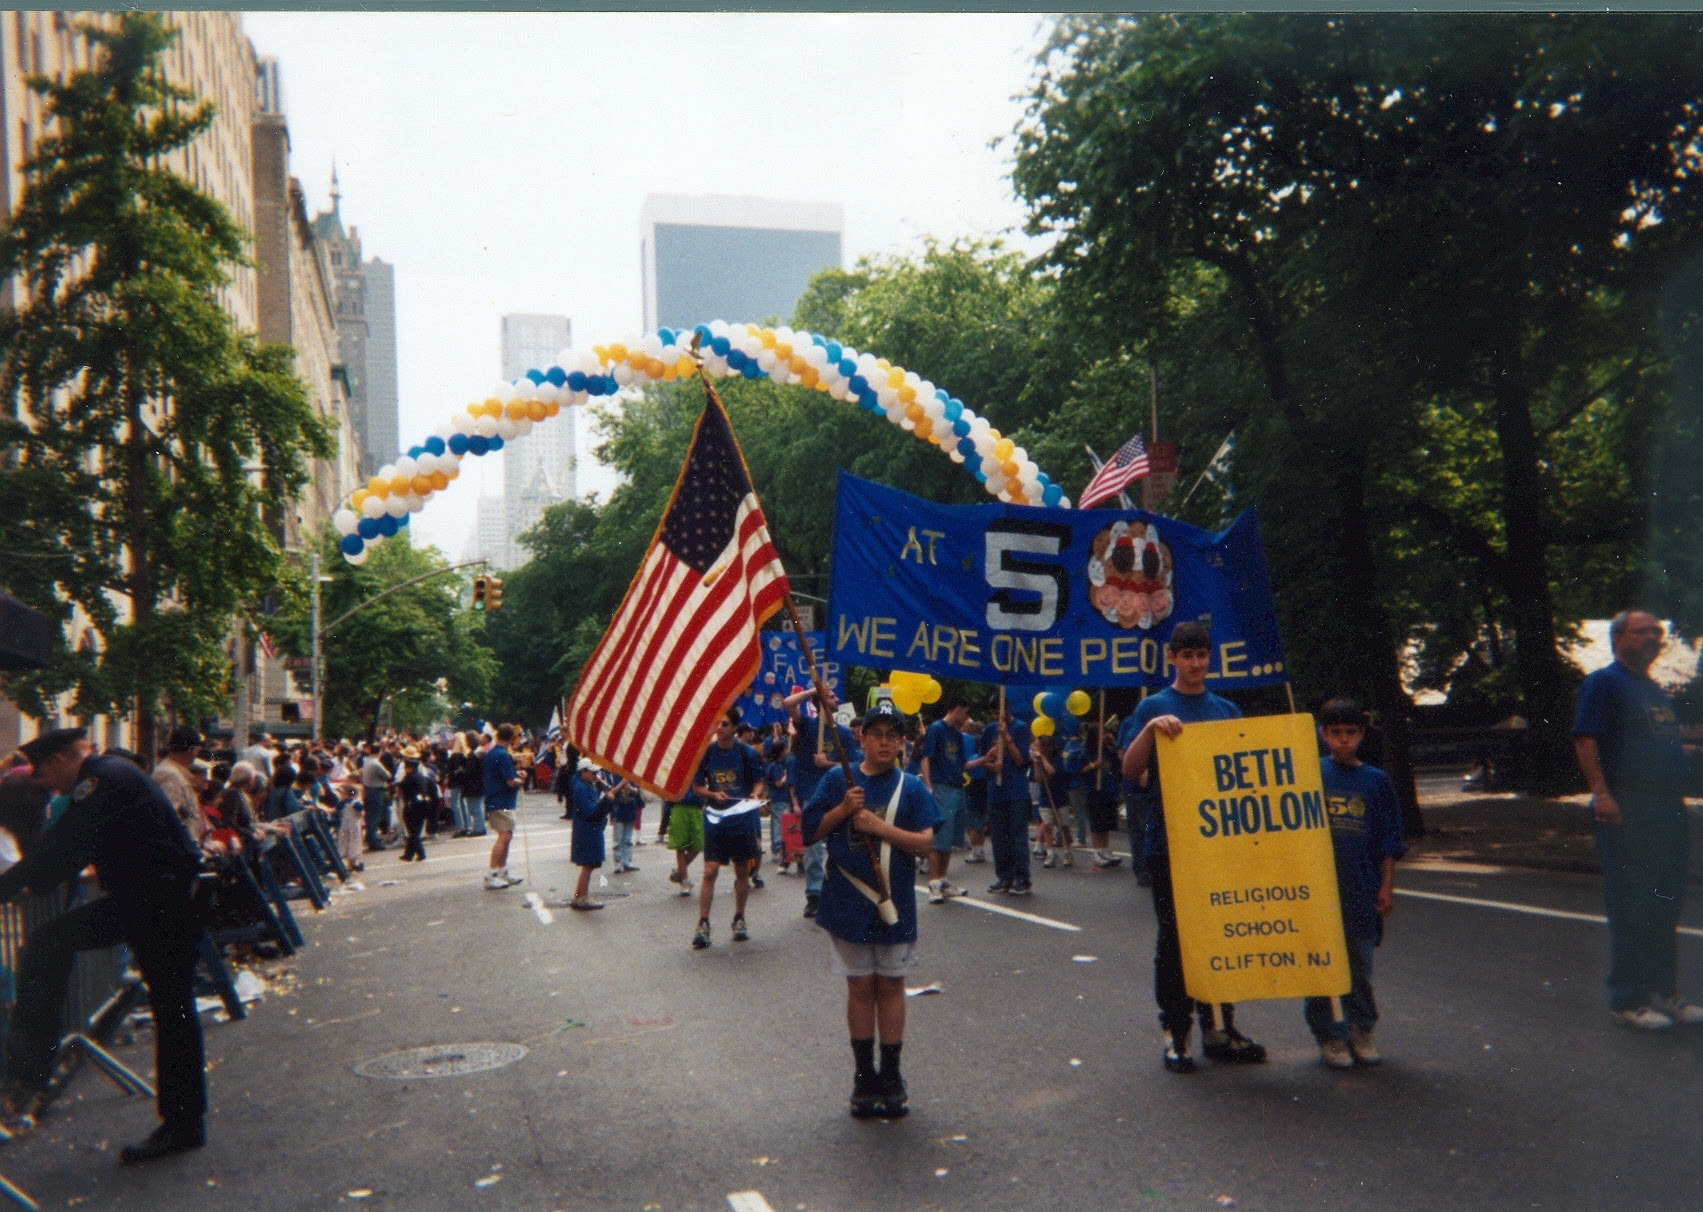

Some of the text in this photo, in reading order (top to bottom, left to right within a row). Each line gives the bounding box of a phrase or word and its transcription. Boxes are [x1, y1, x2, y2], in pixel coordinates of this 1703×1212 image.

[901, 525, 946, 565] AT
[837, 614, 897, 658] WE
[906, 620, 981, 668] ARE
[991, 634, 1065, 676] ONE
[1212, 746, 1296, 792] BETH
[1197, 790, 1327, 838] SHOLOM
[1210, 885, 1310, 906] RELIGIOUS
[1223, 919, 1299, 938] SCHOOL
[1307, 951, 1332, 968] NJ
